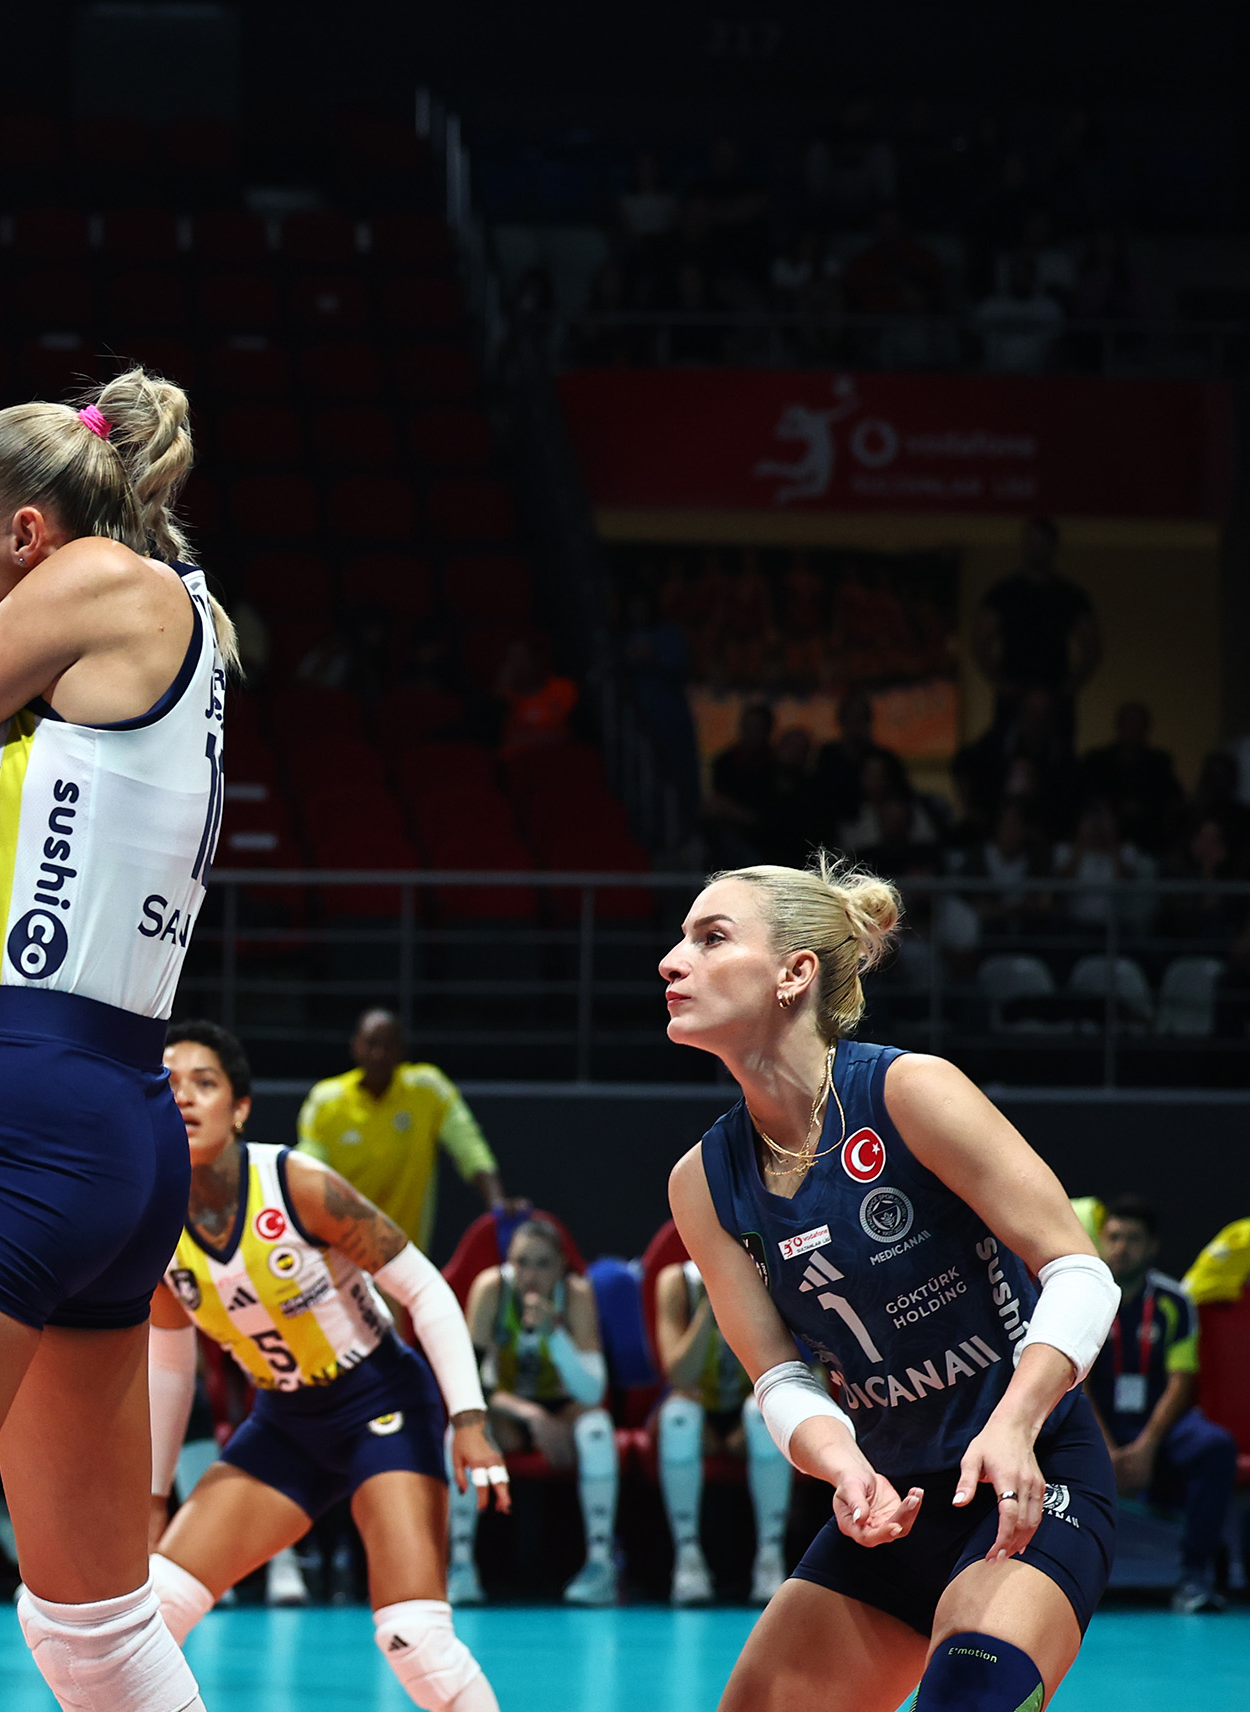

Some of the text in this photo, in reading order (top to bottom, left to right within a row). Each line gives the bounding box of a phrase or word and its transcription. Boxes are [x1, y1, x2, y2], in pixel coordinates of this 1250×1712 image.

[886, 1265, 960, 1314] GÖKTÜRK
[893, 1281, 967, 1330] HOLDİNG
[251, 1330, 297, 1373] 5
[817, 1291, 884, 1364] 1
